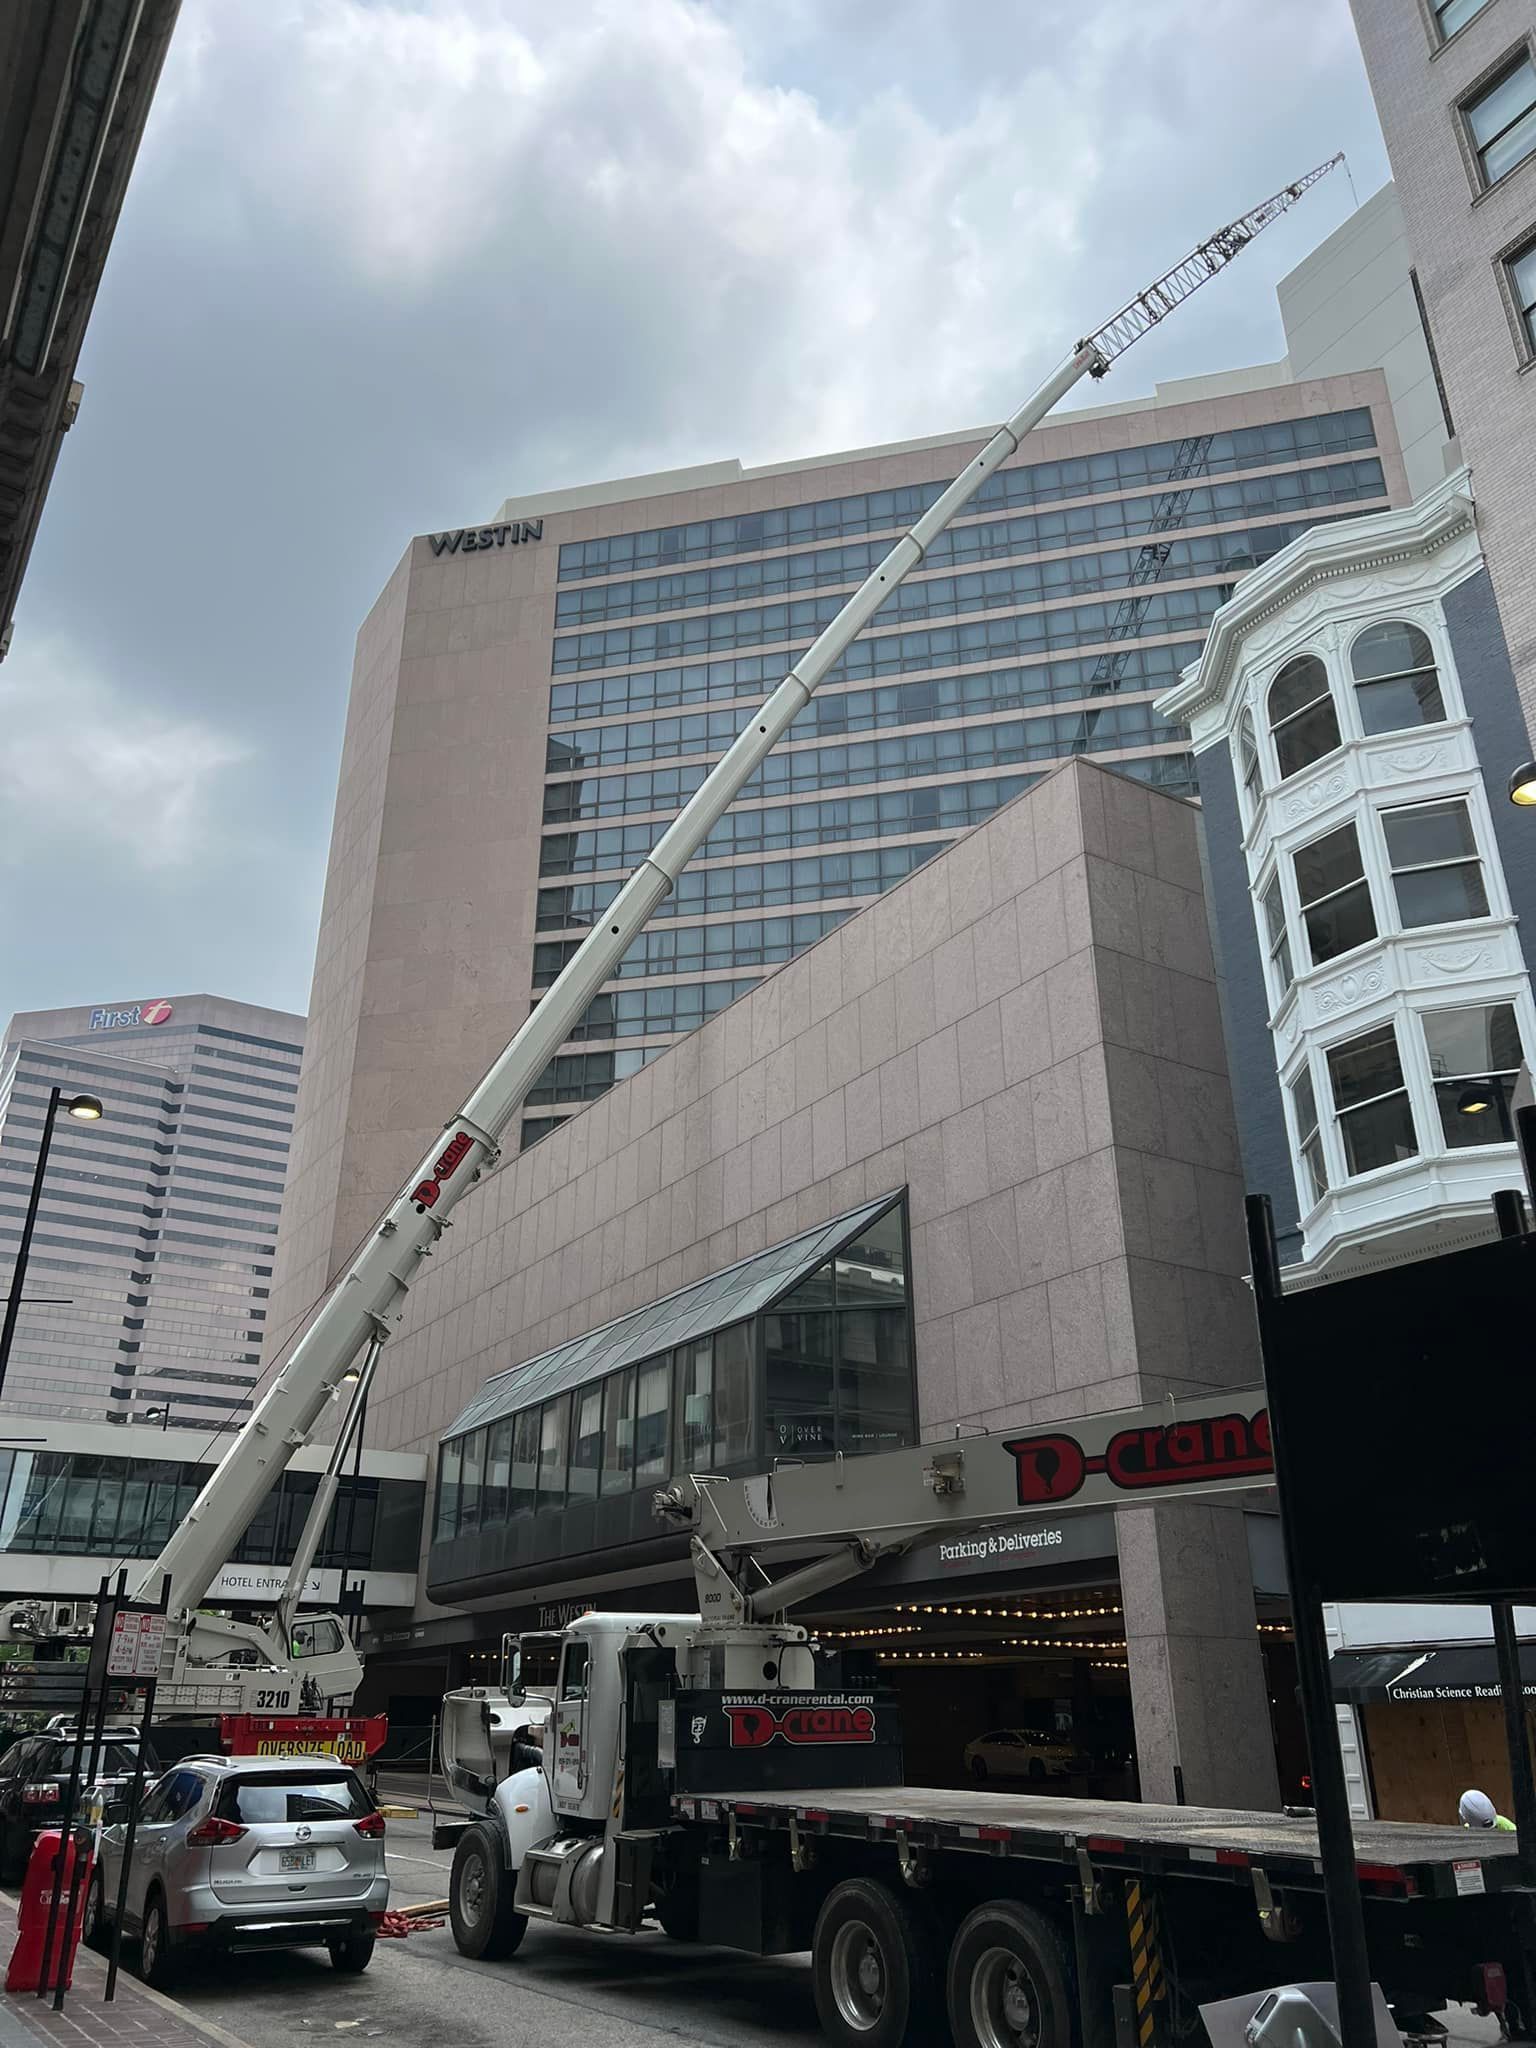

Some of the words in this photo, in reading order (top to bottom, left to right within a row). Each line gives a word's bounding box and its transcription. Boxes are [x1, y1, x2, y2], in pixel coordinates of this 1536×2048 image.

[429, 519, 543, 557] WESTIN
[88, 1004, 141, 1031] First
[797, 1433, 822, 1441] VINE
[939, 1540, 987, 1561] Parking
[988, 1537, 997, 1553] &
[998, 1529, 1063, 1552] Deliveries
[221, 1577, 253, 1588] HOTEL
[256, 1578, 307, 1590] ENTRAE
[538, 1607, 557, 1628] THE
[257, 1690, 290, 1709] 3210
[721, 1693, 874, 1706] www.d-cranerental.com
[1393, 1687, 1434, 1700] Christian
[1436, 1686, 1472, 1698] Science
[1475, 1684, 1502, 1697] Readi
[261, 1741, 325, 1756] OVERSIZE
[329, 1741, 363, 1760] LOAD
